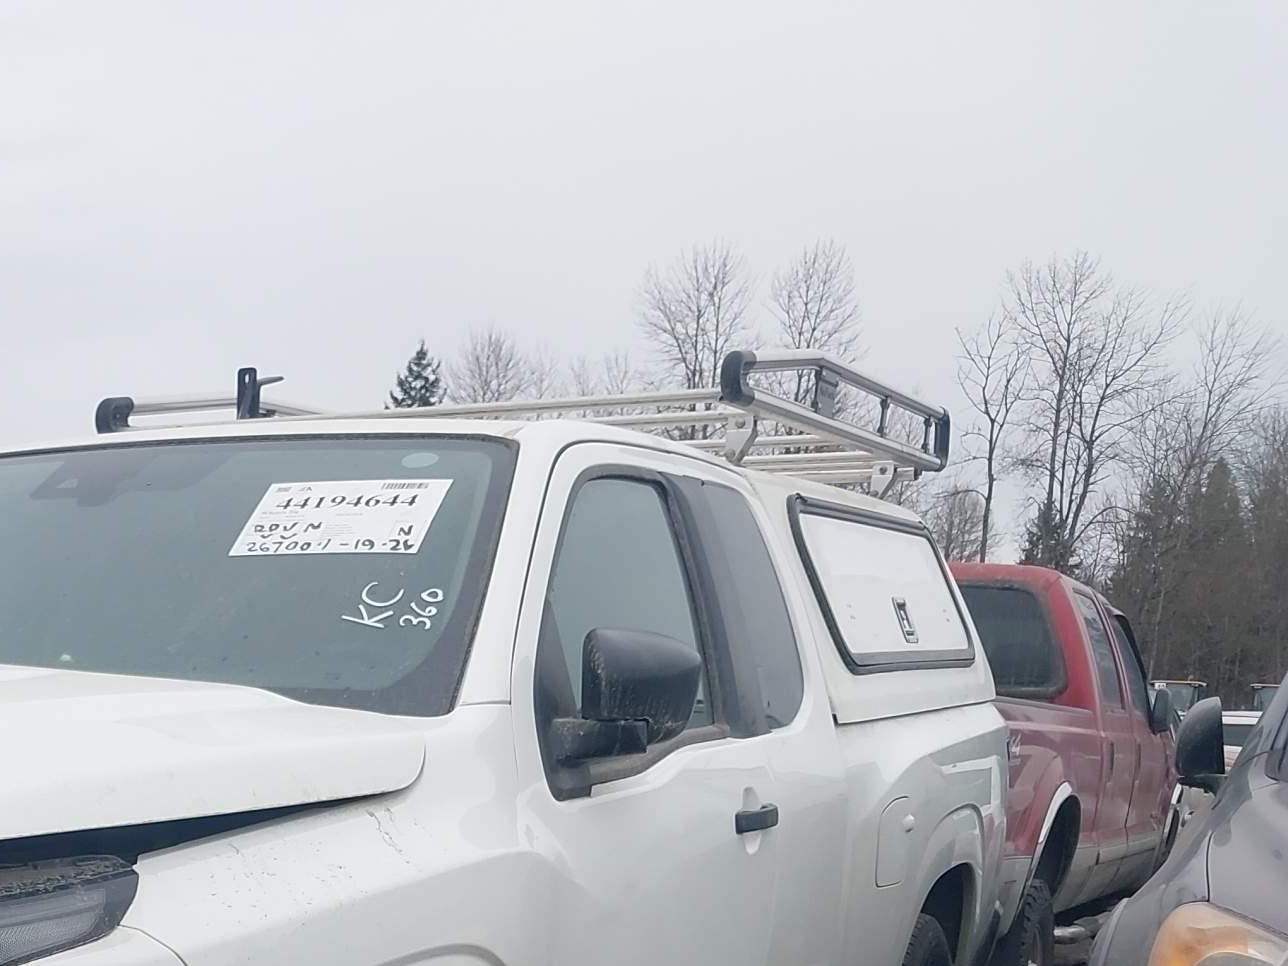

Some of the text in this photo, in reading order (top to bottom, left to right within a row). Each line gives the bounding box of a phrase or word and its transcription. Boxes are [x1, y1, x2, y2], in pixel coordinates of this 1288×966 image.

[275, 494, 418, 510] 44194644
[341, 581, 404, 628] KC
[399, 588, 444, 629] 360
